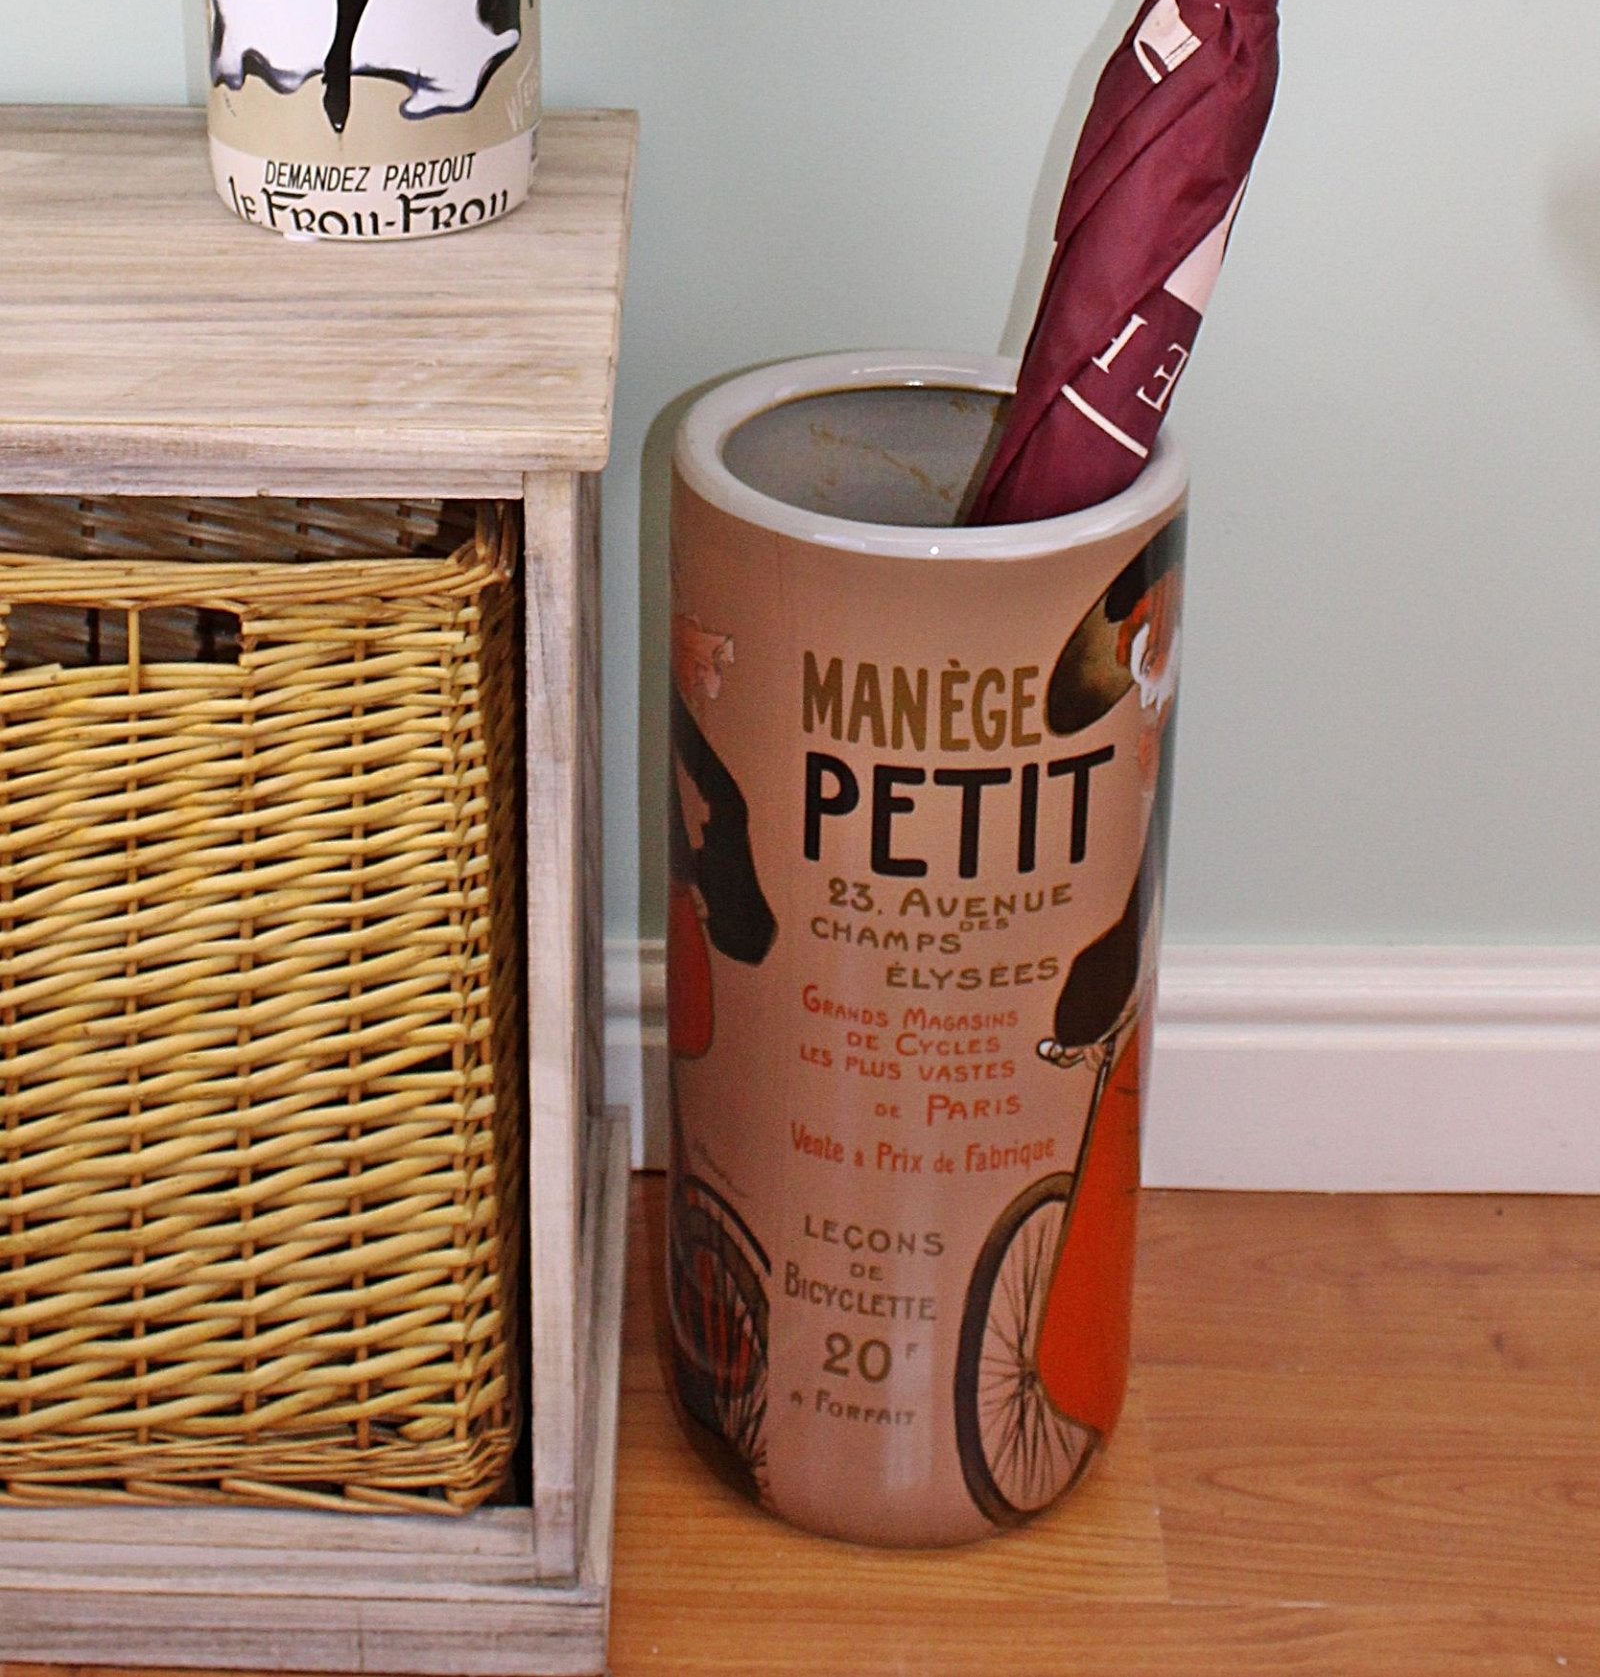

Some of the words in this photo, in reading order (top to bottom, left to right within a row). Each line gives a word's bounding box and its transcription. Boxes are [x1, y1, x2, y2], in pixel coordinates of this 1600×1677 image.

[265, 160, 371, 193] DEMANDEZ
[383, 152, 477, 191] PARTOUT
[802, 650, 1042, 753] MANÈGE
[803, 744, 1116, 879] PETIT
[900, 883, 1073, 918] AVENUE
[810, 916, 962, 955] CHAMPS
[959, 918, 1010, 933] DES
[886, 957, 1060, 991] ÉLYSÉES
[802, 984, 888, 1028] GRANDS
[902, 1007, 1019, 1032] MAGASINS
[800, 1043, 834, 1068] LES
[845, 1056, 901, 1081] PLUS
[918, 1059, 1016, 1083] VASTES
[846, 1031, 880, 1051] DE
[896, 1032, 1001, 1057] CYCLES
[926, 1093, 1021, 1126] PARIS
[876, 1140, 925, 1174] Prix
[934, 1150, 955, 1174] de
[784, 1260, 937, 1321] BICYCLETTE
[850, 1262, 884, 1282] DE
[822, 1331, 892, 1384] 20
[814, 1388, 917, 1425] FORFAIT
